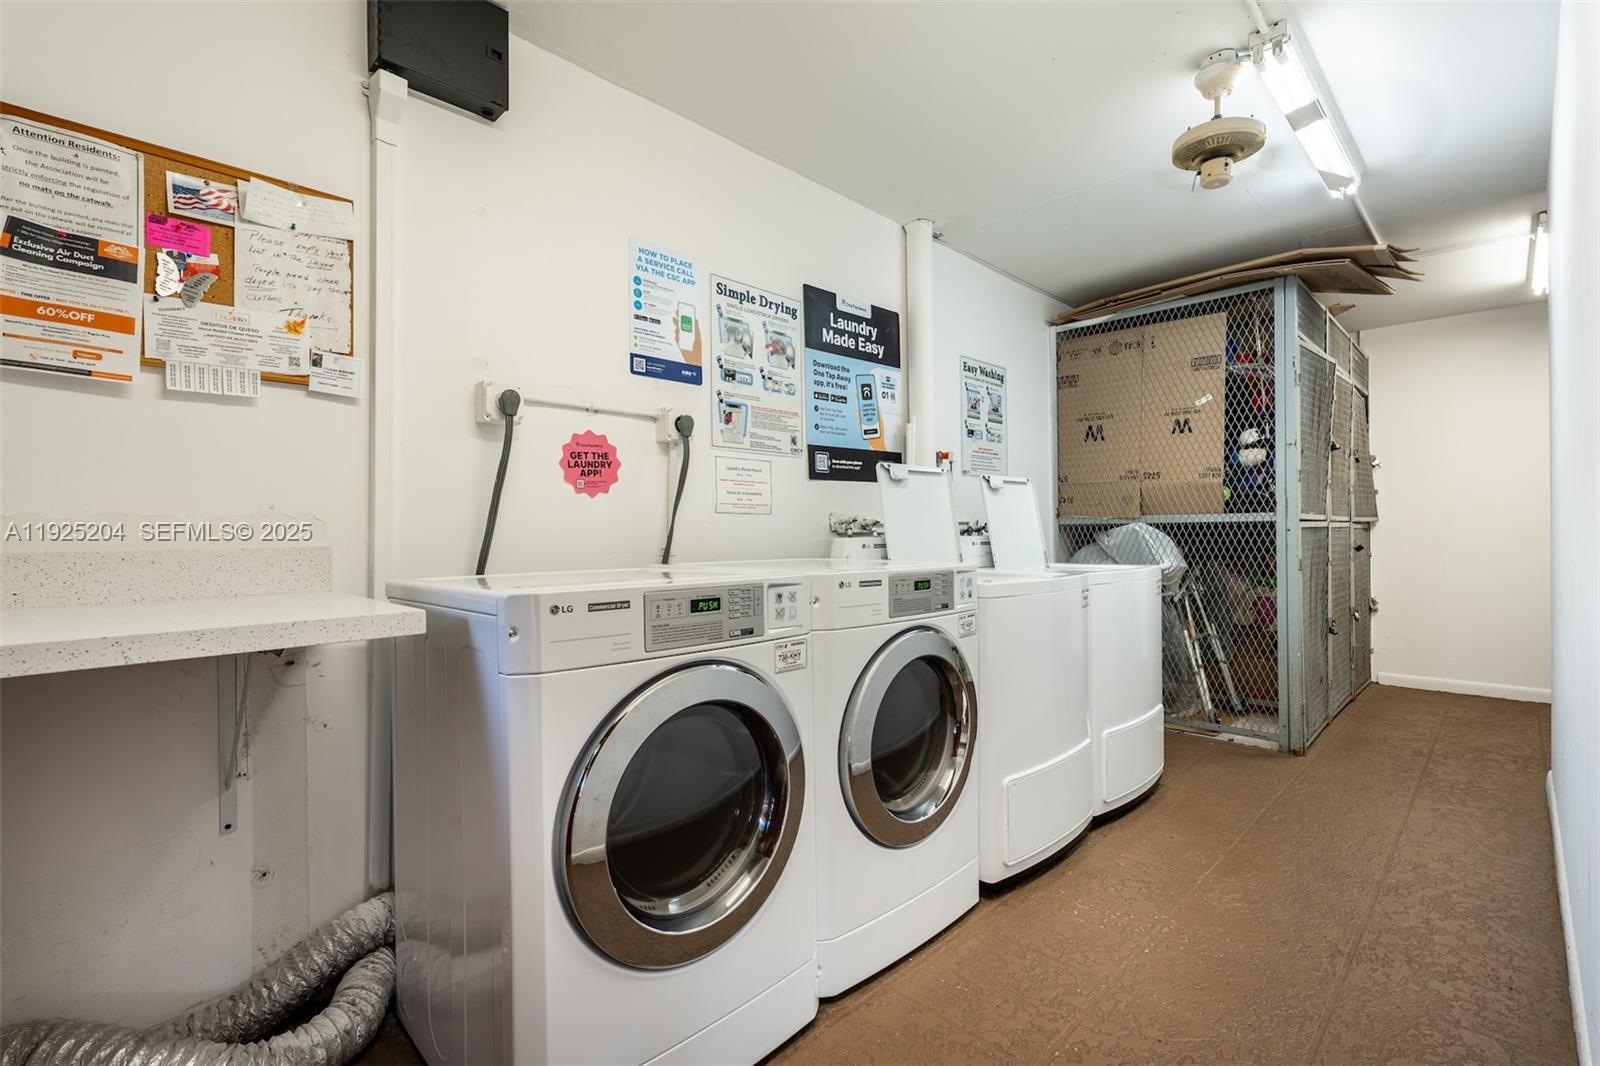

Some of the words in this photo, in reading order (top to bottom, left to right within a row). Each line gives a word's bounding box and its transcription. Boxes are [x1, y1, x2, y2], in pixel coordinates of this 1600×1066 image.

[13, 126, 65, 146] Attention
[68, 140, 121, 161] Residents:
[13, 145, 34, 154] Once
[50, 154, 81, 168] building
[40, 163, 84, 179] Association
[86, 175, 99, 183] will
[31, 173, 68, 187] enforcing
[69, 181, 82, 189] the
[84, 186, 121, 199] regulation
[32, 183, 52, 194] mats
[66, 192, 80, 200] the
[81, 196, 114, 209] catwalk.
[242, 228, 285, 247] Please
[11, 243, 54, 262] Cleaning
[56, 255, 105, 271] Campaign
[13, 235, 55, 254] Exclusive
[57, 248, 73, 257] Air
[74, 251, 95, 262] Duct
[638, 247, 658, 258] HOW
[659, 253, 670, 262] TO
[670, 256, 694, 270] PLACE
[635, 263, 650, 274] VIA
[651, 268, 666, 279] THE
[666, 272, 681, 283] CSC
[681, 277, 697, 287] APP
[637, 255, 643, 263] A
[644, 258, 676, 273] SERVICE
[676, 267, 695, 279] CALL
[716, 282, 757, 305] Simple
[758, 294, 799, 321] Drying
[36, 306, 96, 323] 60%OFF
[238, 326, 260, 334] QUESO
[830, 312, 878, 341] Laundry
[822, 327, 856, 349] Made
[858, 337, 885, 359] Easy
[812, 359, 841, 372] Download
[813, 368, 825, 377] One
[826, 371, 836, 380] Tap
[836, 373, 851, 384] Away
[963, 361, 978, 377] Easy
[979, 365, 1004, 385] Washing
[813, 379, 826, 388] app,
[835, 382, 848, 391] free!
[567, 460, 613, 469] LAUNDRY
[570, 452, 589, 460] GET
[591, 452, 609, 461] THE
[580, 469, 602, 477] APP!
[561, 604, 574, 613] LG
[589, 603, 616, 611] Commercial
[698, 600, 719, 611] PUSH
